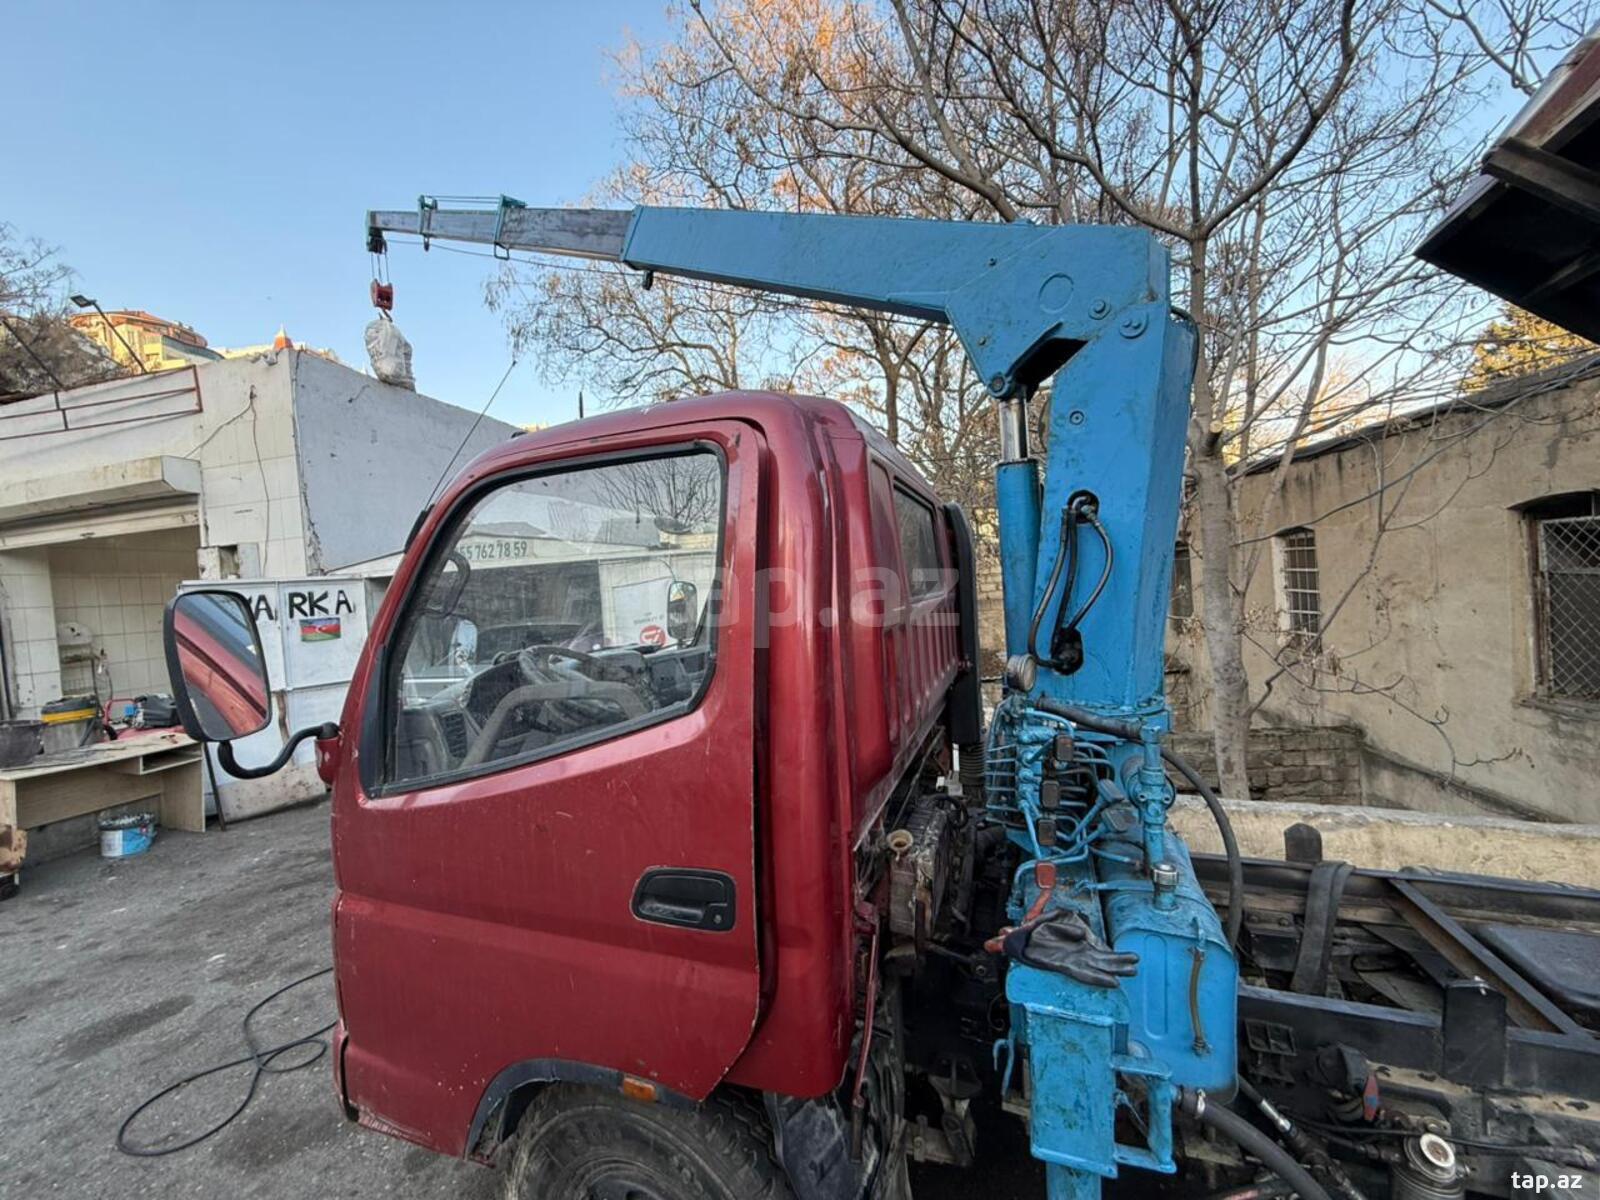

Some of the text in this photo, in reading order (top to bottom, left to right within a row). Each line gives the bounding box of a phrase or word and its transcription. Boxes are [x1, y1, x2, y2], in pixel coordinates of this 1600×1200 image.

[475, 544, 494, 560] 762
[497, 541, 511, 559] 78
[513, 540, 527, 559] 59
